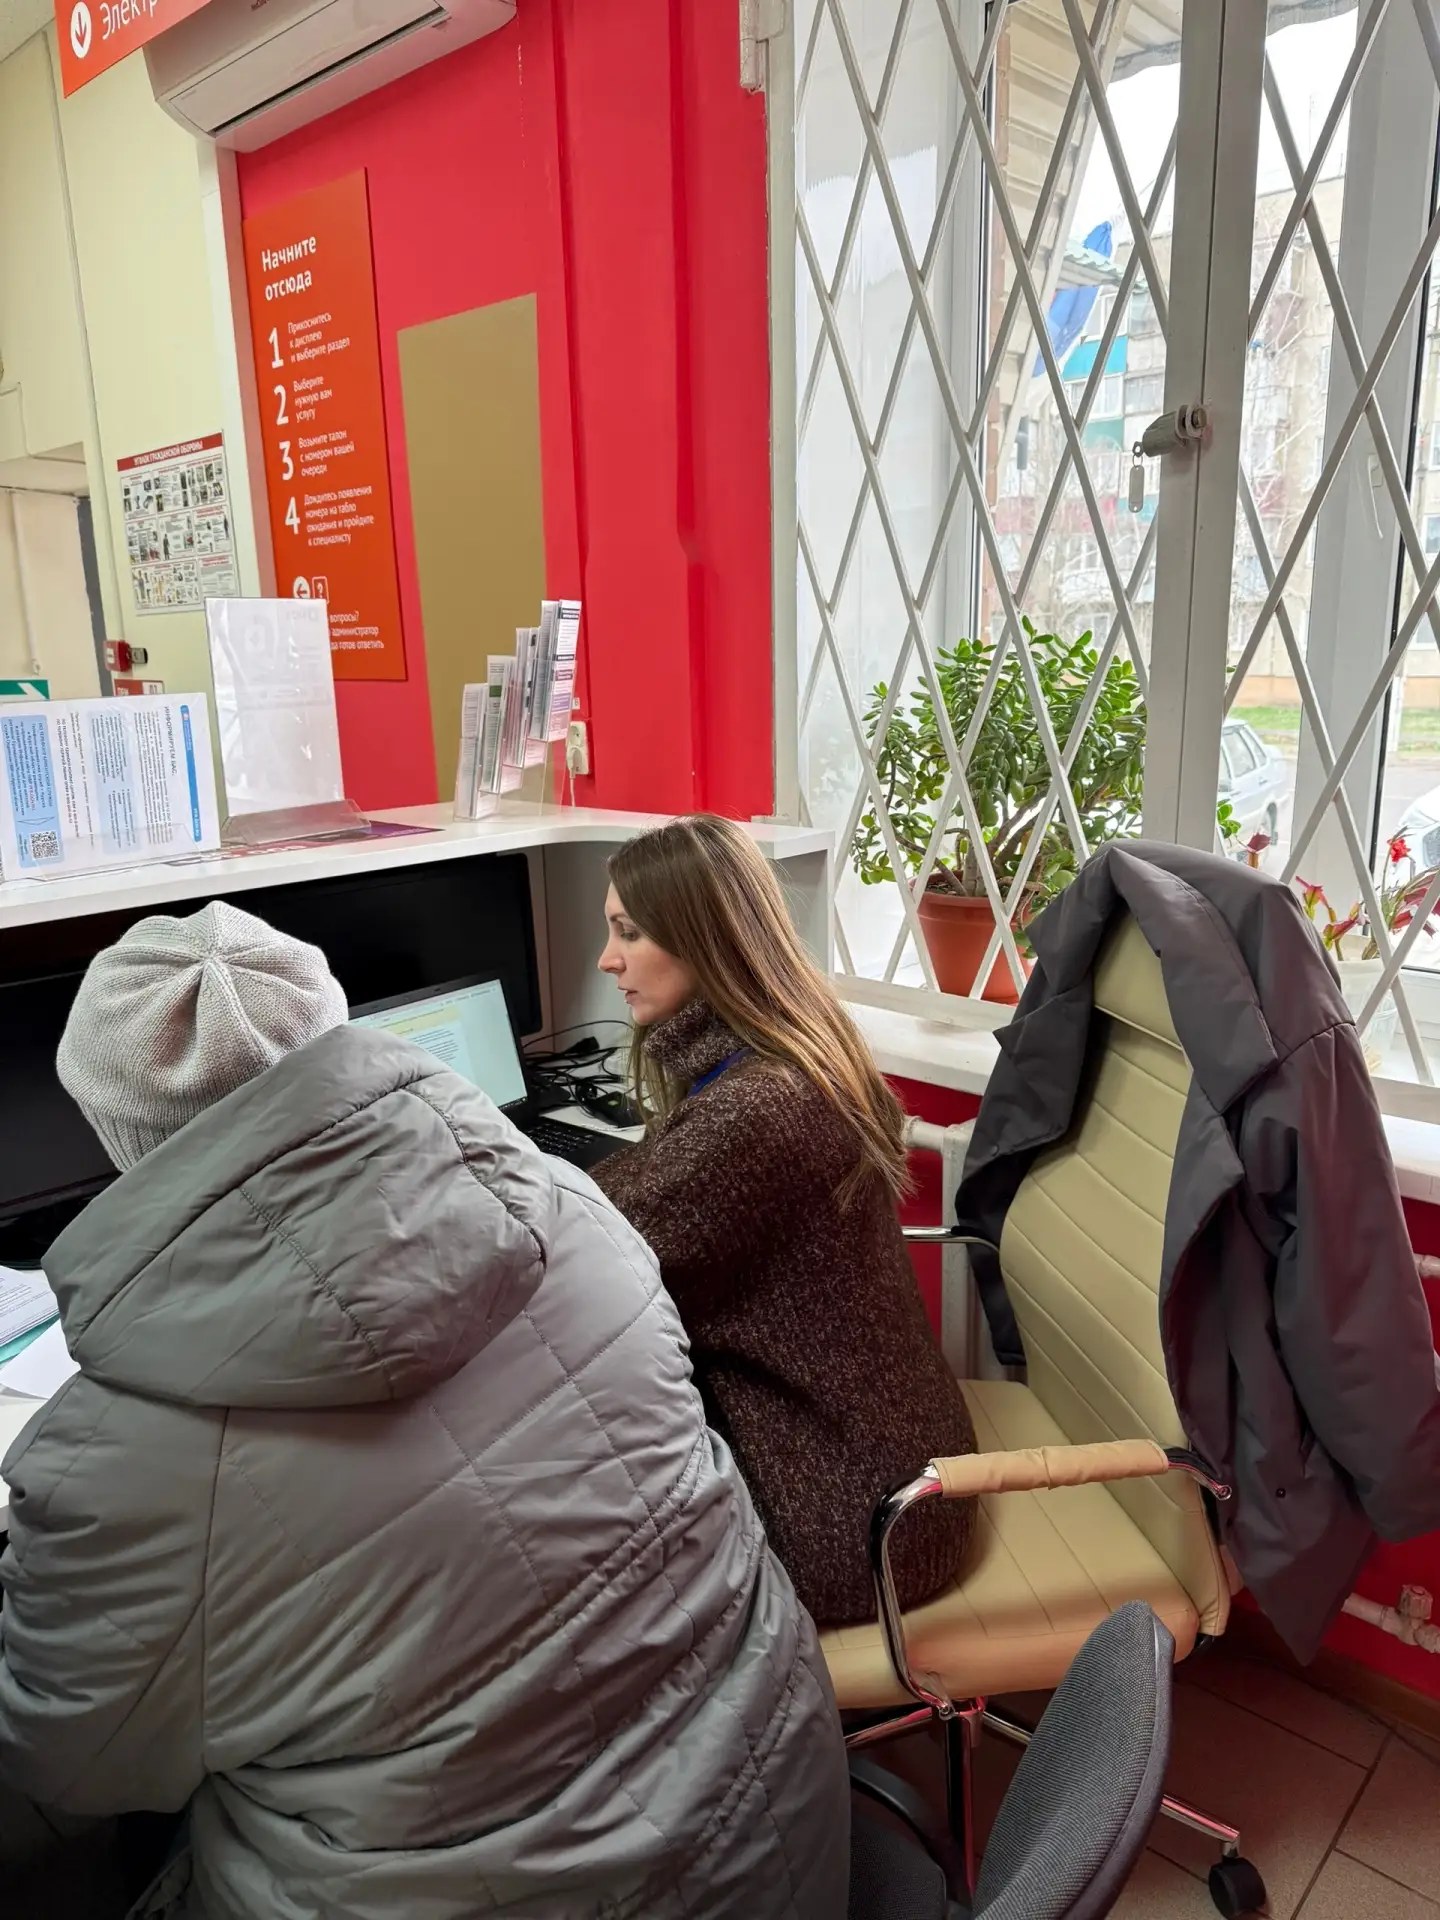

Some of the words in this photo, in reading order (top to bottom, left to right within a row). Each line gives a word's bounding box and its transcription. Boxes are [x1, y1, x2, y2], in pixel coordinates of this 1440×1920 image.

[261, 236, 317, 272] Начните
[265, 270, 312, 301] отсюда
[288, 312, 332, 335] Прикоснитесь
[269, 327, 284, 369] 1
[295, 331, 322, 348] дисплею
[296, 345, 327, 362] выберите
[327, 336, 350, 355] раздел
[294, 376, 324, 392] Выберите
[274, 384, 289, 425] 2
[295, 393, 319, 409] нужную
[319, 388, 332, 400] вам
[296, 408, 316, 423] услугу
[299, 434, 328, 449] Возьмите
[328, 430, 347, 441] талон
[280, 440, 294, 481] 3
[304, 448, 334, 462] номером
[333, 440, 355, 456] вашей
[301, 464, 328, 477] очереди
[304, 492, 338, 507] Дождитесь
[338, 485, 372, 499] появления
[285, 496, 300, 535] 4
[305, 507, 329, 520] номера
[329, 506, 338, 516] на
[338, 501, 357, 514] табло
[307, 520, 337, 533] ожидания
[344, 514, 374, 530] пройдите
[313, 533, 352, 546] специалисту
